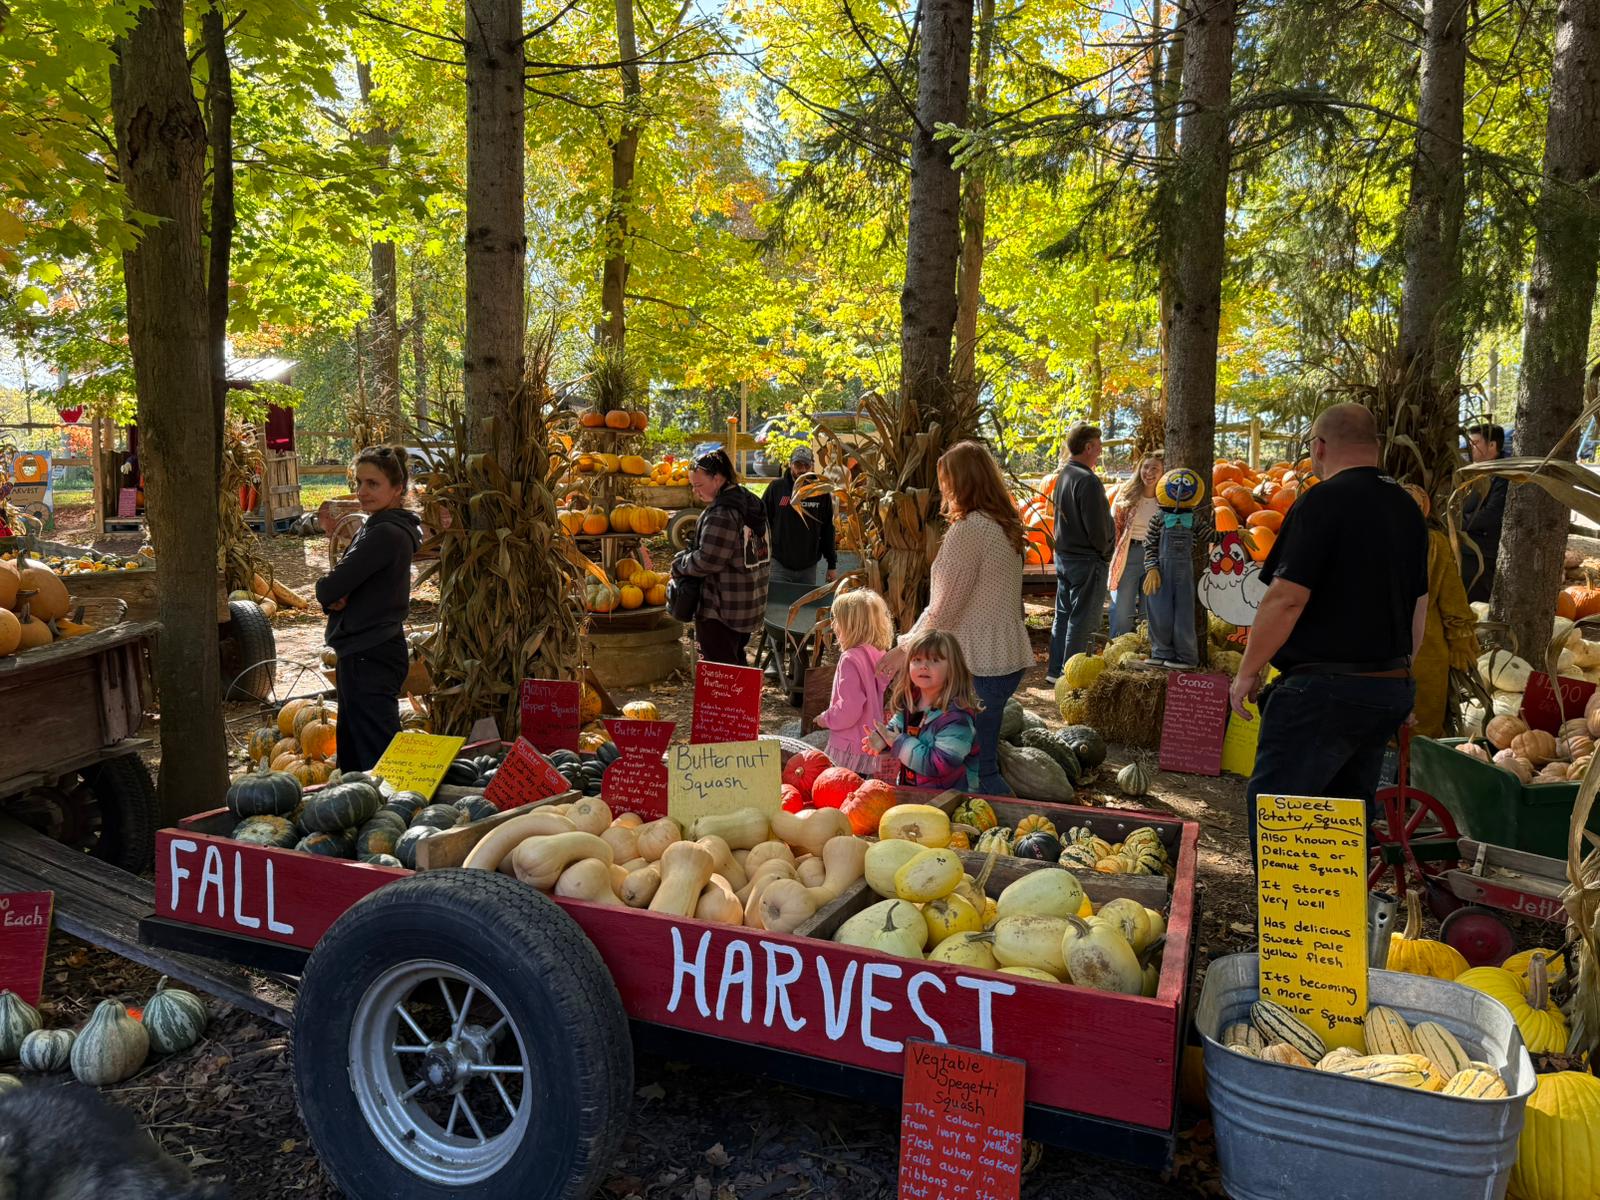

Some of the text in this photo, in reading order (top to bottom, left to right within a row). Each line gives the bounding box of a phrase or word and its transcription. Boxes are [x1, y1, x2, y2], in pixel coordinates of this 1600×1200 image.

[11, 487, 38, 495] ARVEST
[1177, 674, 1214, 690] Gonzo
[614, 722, 662, 737] Butter Nut
[517, 740, 541, 766] Butter
[677, 745, 769, 770] Butternut
[682, 773, 748, 799] Squash
[1275, 798, 1335, 812] Sweet
[1258, 808, 1362, 830] Potato Squash
[1261, 832, 1288, 843] Also
[1342, 839, 1360, 848] as
[1262, 846, 1320, 860] Delicata
[170, 839, 294, 935] FALL
[1262, 880, 1281, 890] It
[1298, 899, 1326, 910] well
[4, 905, 42, 927] Each
[1264, 916, 1352, 938] Has delicious
[1262, 947, 1344, 969] yellow flesh
[666, 926, 1016, 1054] HARVEST
[1262, 988, 1272, 996] a
[1300, 974, 1358, 1006] becoming
[1282, 1004, 1314, 1015] ular
[913, 1047, 983, 1080] Vegtable
[937, 1068, 1000, 1102] Spegetti
[902, 1114, 928, 1131] from
[965, 1133, 976, 1144] to
[983, 1138, 1014, 1156] yellow
[946, 1114, 982, 1130] colour
[987, 1126, 1022, 1148] ranges
[904, 1148, 996, 1186] falls away in
[900, 1166, 969, 1194] ribbons or
[902, 1182, 928, 1198] that
